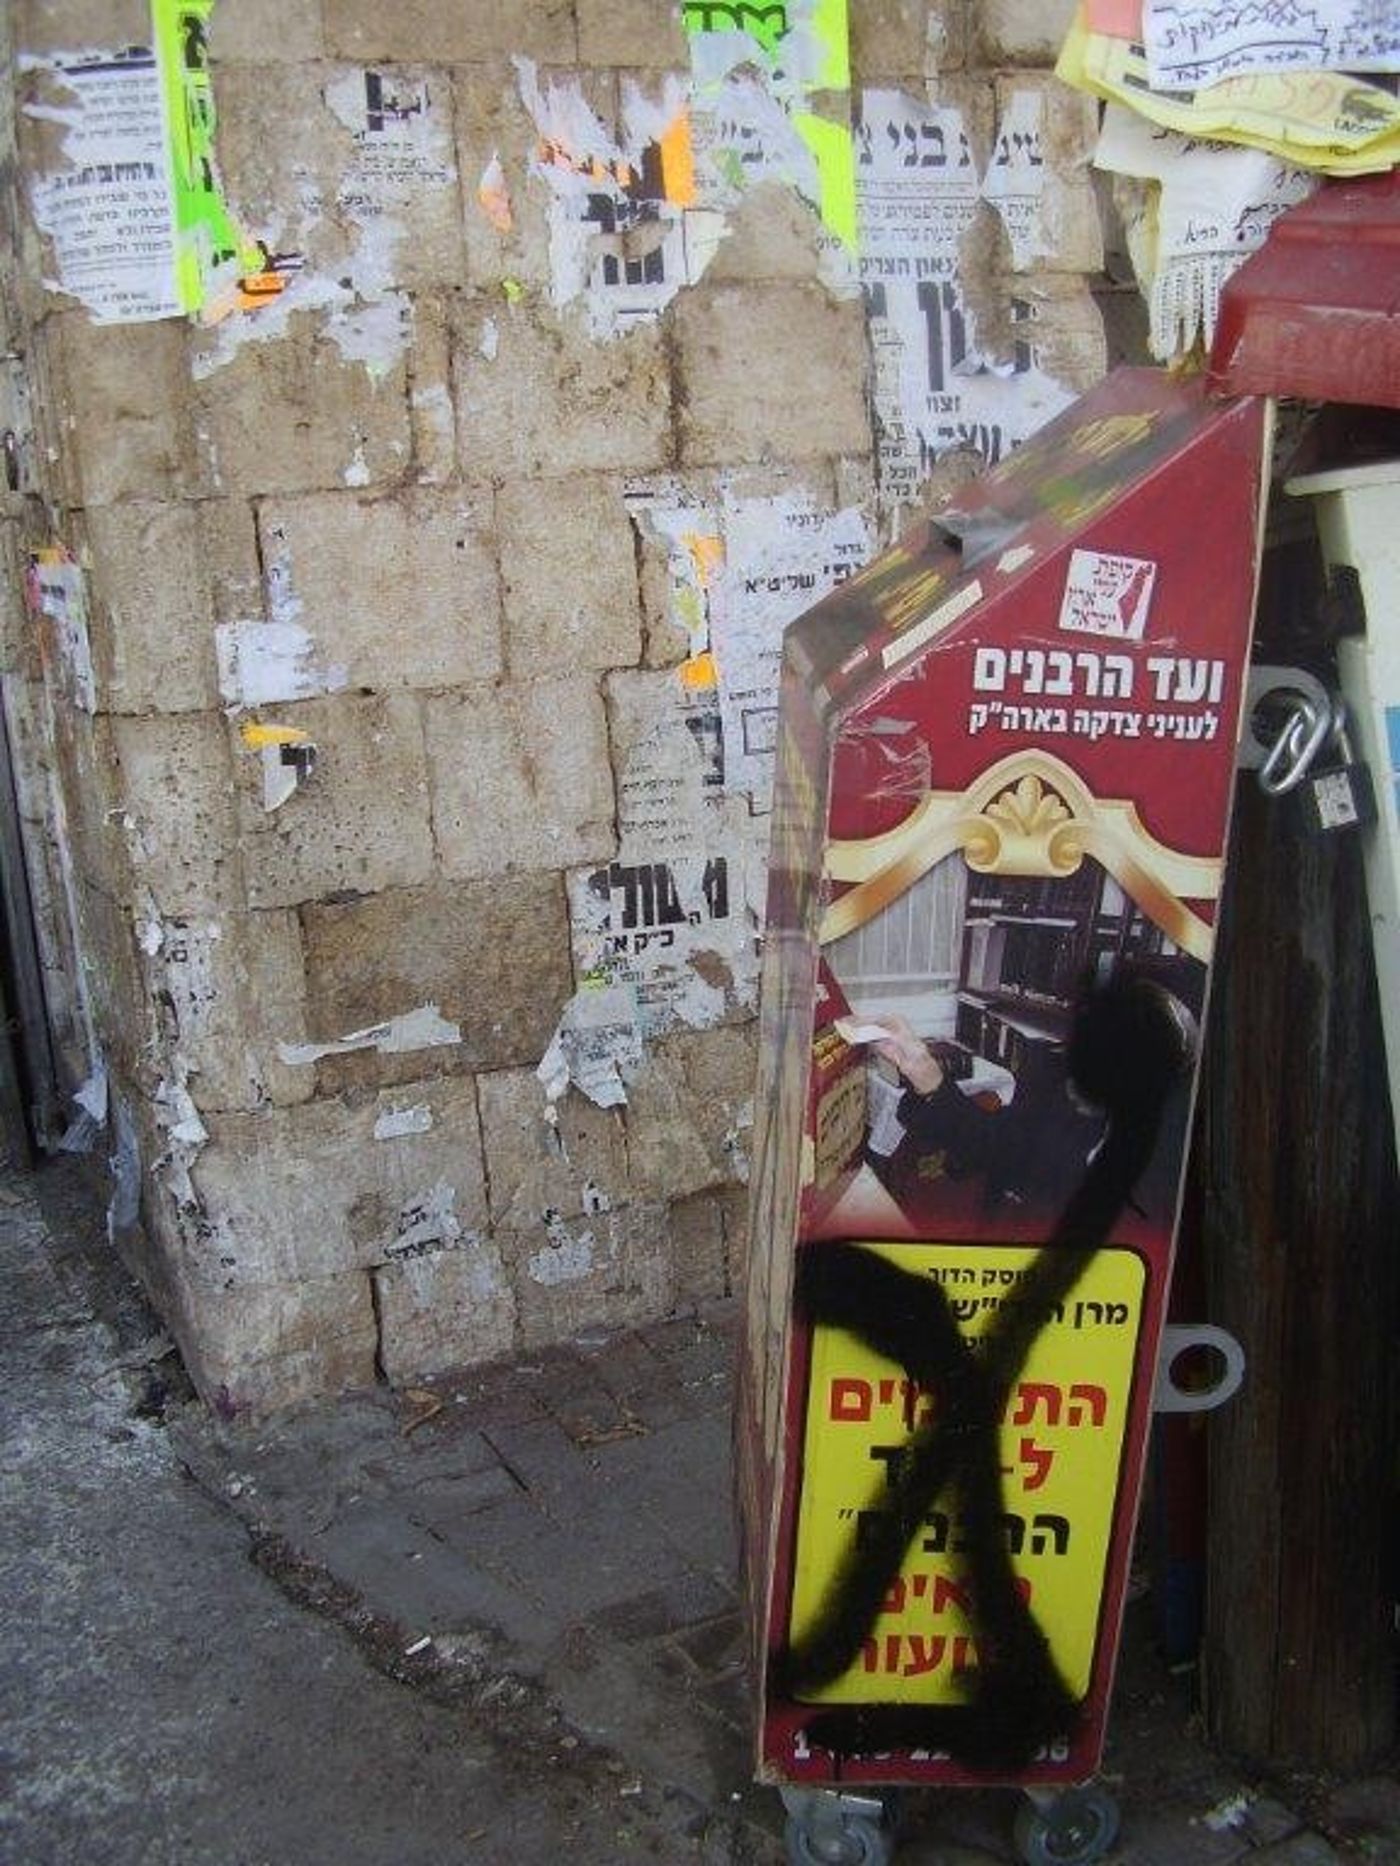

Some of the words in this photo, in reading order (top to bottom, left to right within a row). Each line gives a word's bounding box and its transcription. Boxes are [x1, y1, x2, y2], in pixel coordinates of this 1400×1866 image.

[973, 648, 1135, 698] הרבנים
[1147, 657, 1225, 703] ועד
[1073, 708, 1142, 740] צדקה
[1147, 710, 1218, 740] לעניני
[1074, 1300, 1129, 1328] מרן
